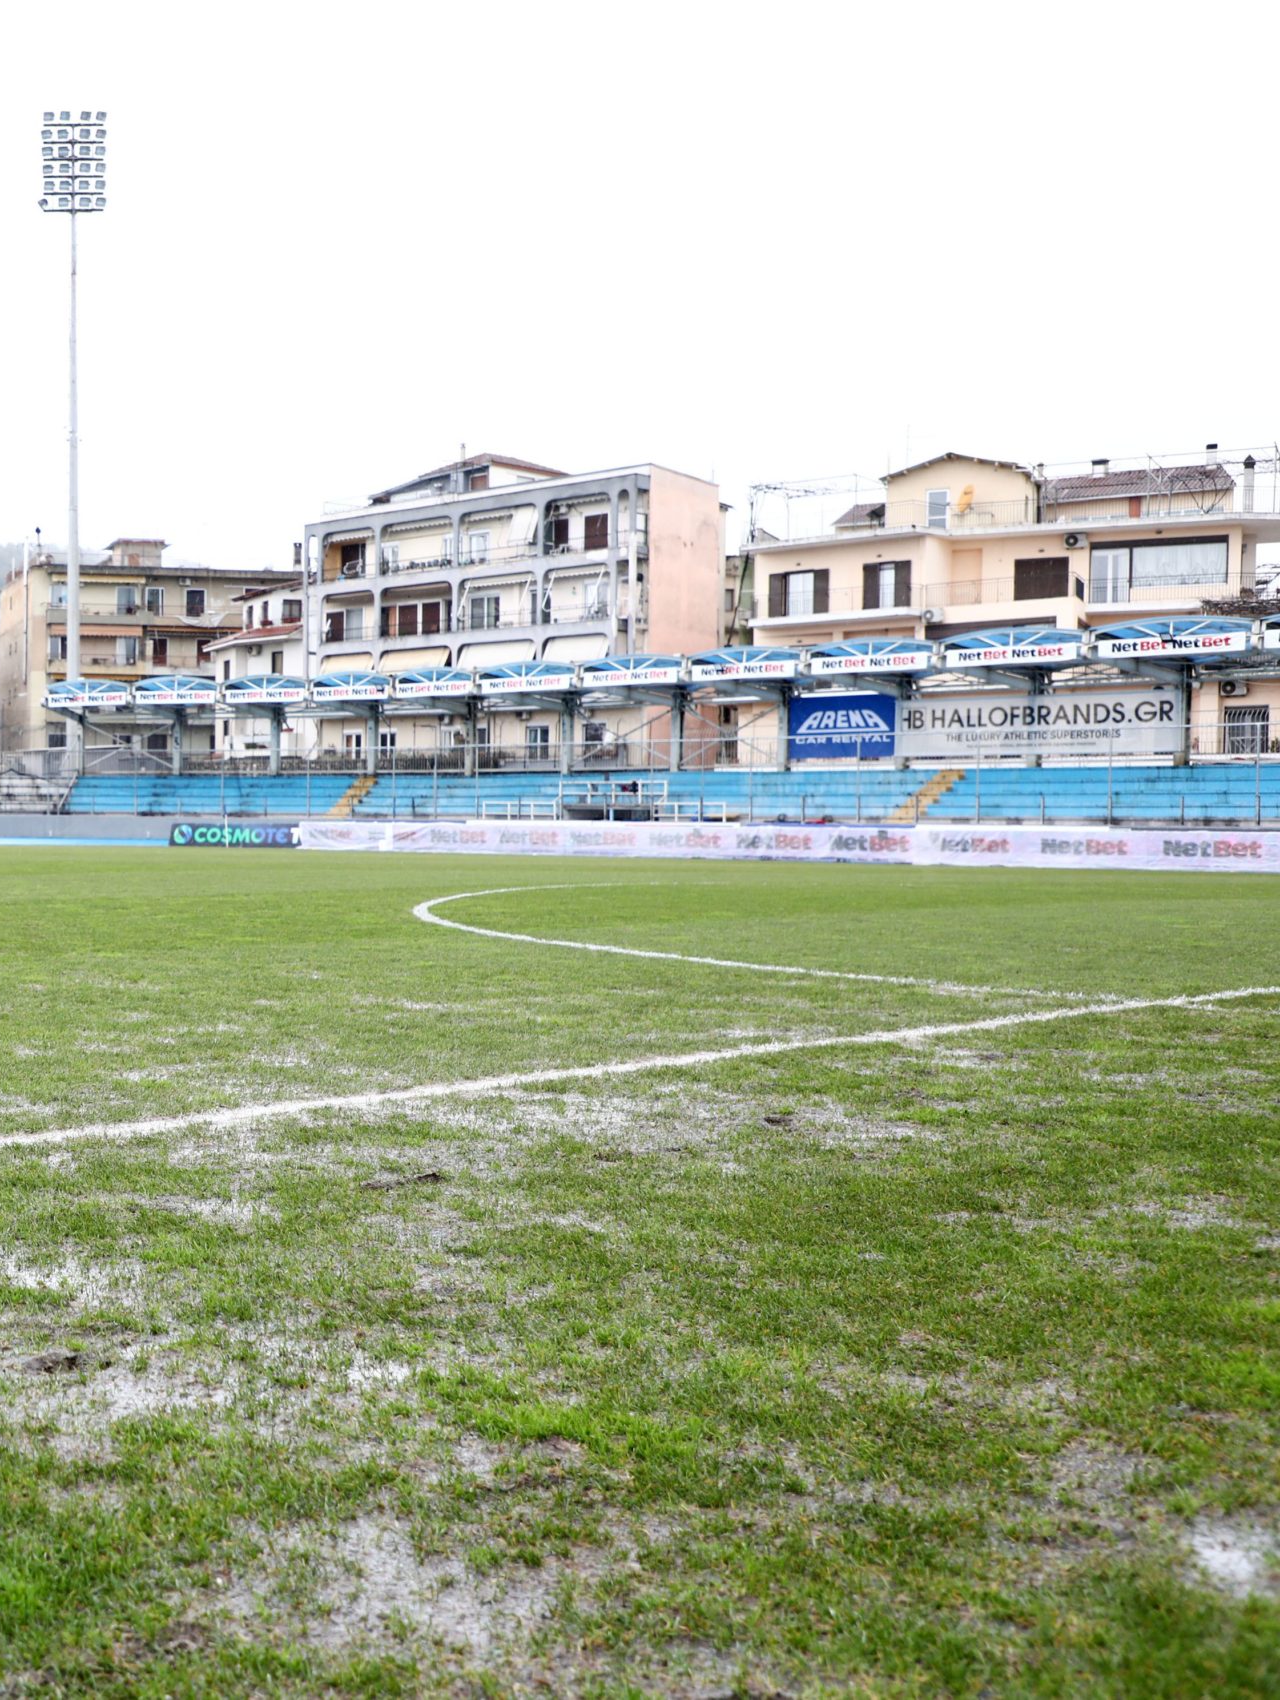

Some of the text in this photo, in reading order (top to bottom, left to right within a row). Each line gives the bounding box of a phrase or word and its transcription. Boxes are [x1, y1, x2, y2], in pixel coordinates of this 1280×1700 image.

[1111, 635, 1231, 653] NetBet NetBet
[958, 646, 1064, 662] NetBet NetBet
[822, 655, 916, 669] NetBet NetBet
[743, 664, 784, 674] NetBet
[592, 670, 668, 682] NetBet NetBet
[398, 683, 467, 694] NetBet NetBet
[489, 677, 561, 689] NetBet NetBet
[88, 694, 123, 703] NetBet
[140, 692, 211, 701] NetBet NetBet
[230, 691, 300, 699] NetBet NetBet
[316, 687, 385, 697] NetBet NetB
[797, 709, 890, 732] ARENA
[931, 700, 1174, 729] HALLOFBRANDS.GR
[795, 733, 891, 744] CAR RENTAL
[946, 727, 1122, 743] THE LUXURY ATHLETIC SUPERSTORES
[194, 827, 288, 844] COSMOTE
[431, 828, 487, 845] NetBet
[736, 833, 812, 851] NetBet
[830, 834, 910, 853] NetBet
[1040, 838, 1128, 856] NetBet
[1162, 840, 1263, 859] NetBet
